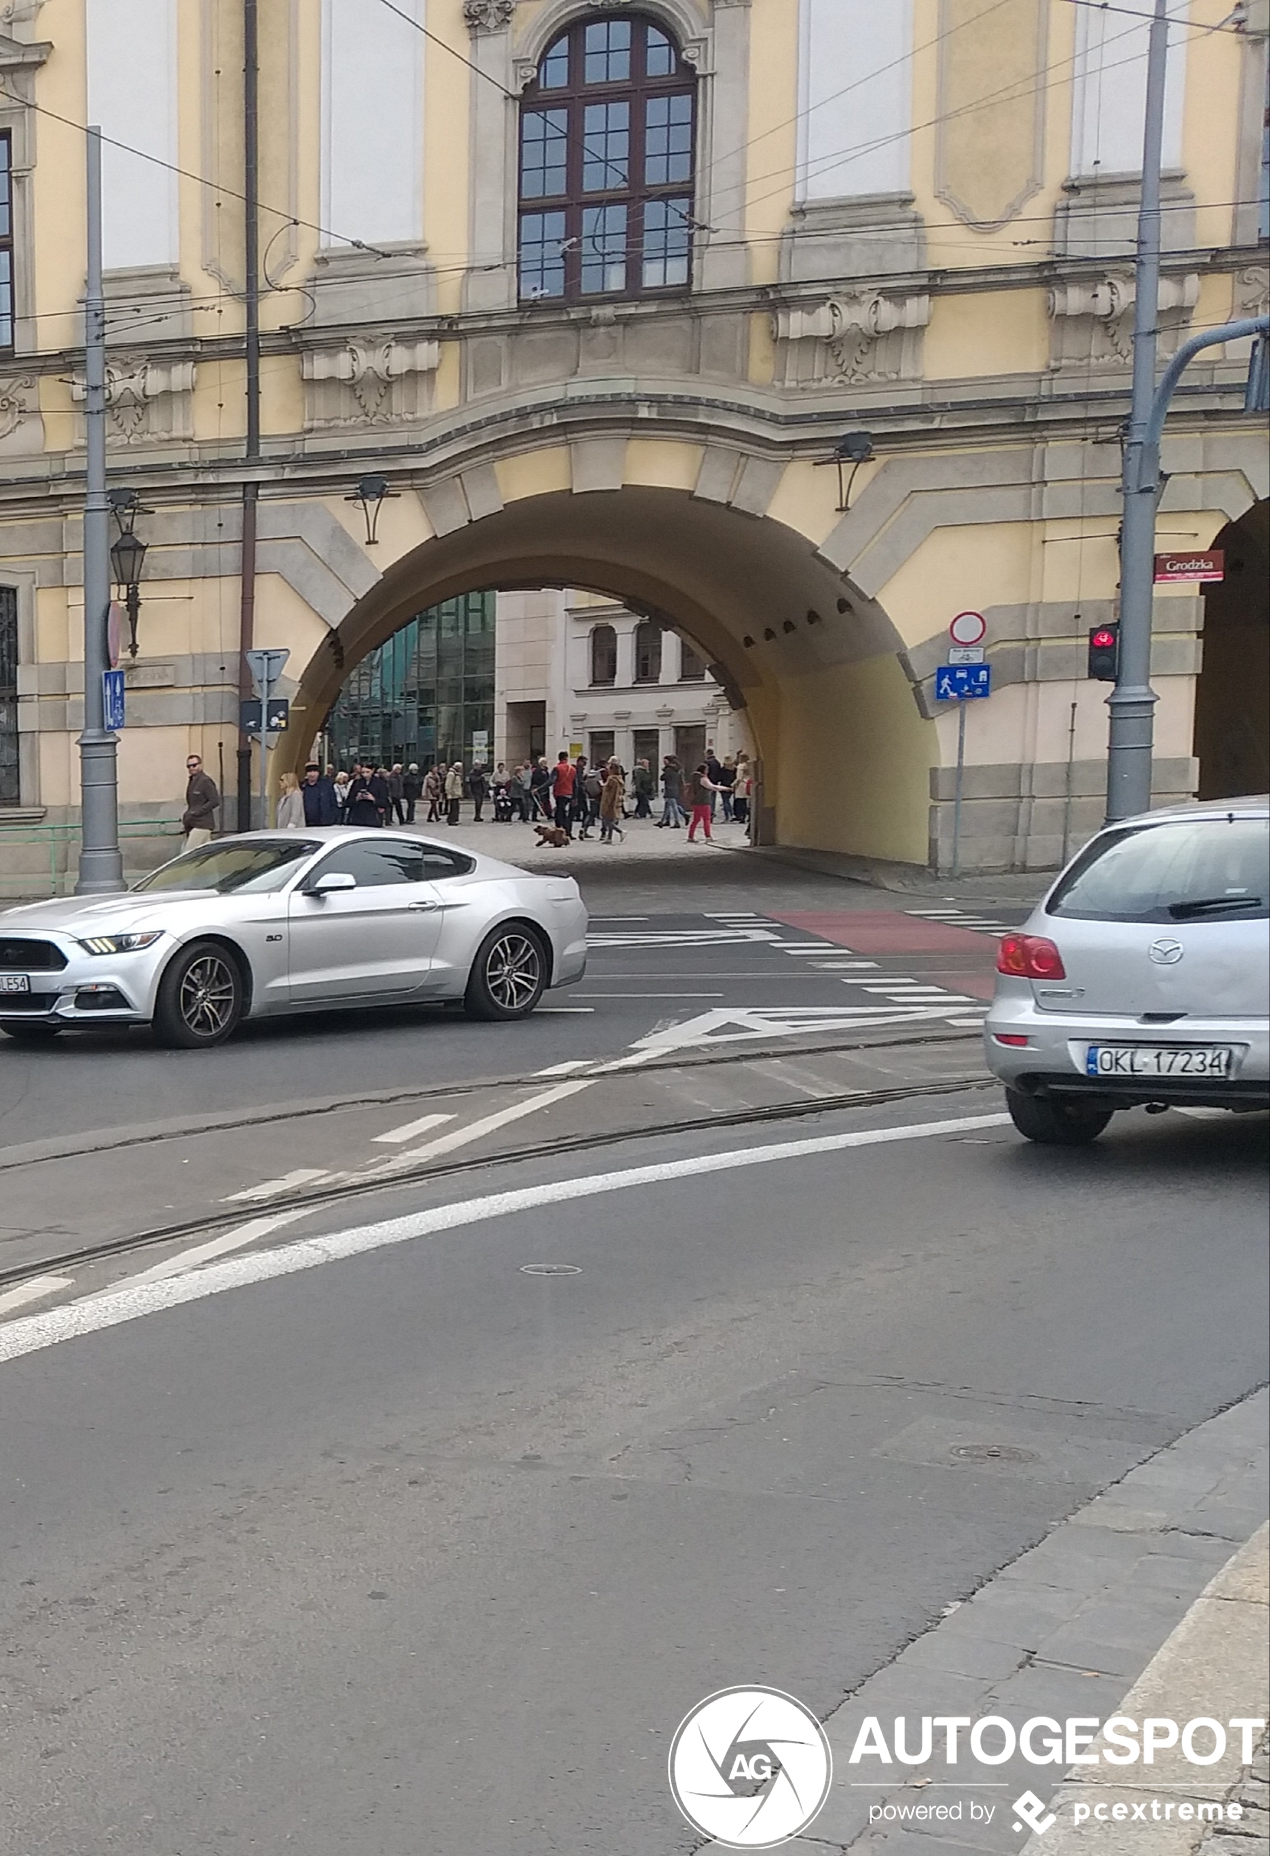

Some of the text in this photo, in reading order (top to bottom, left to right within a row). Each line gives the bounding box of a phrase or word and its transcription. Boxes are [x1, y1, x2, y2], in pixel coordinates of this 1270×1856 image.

[1166, 559, 1214, 571] Grodzka
[1100, 1050, 1223, 1073] OKL 17234
